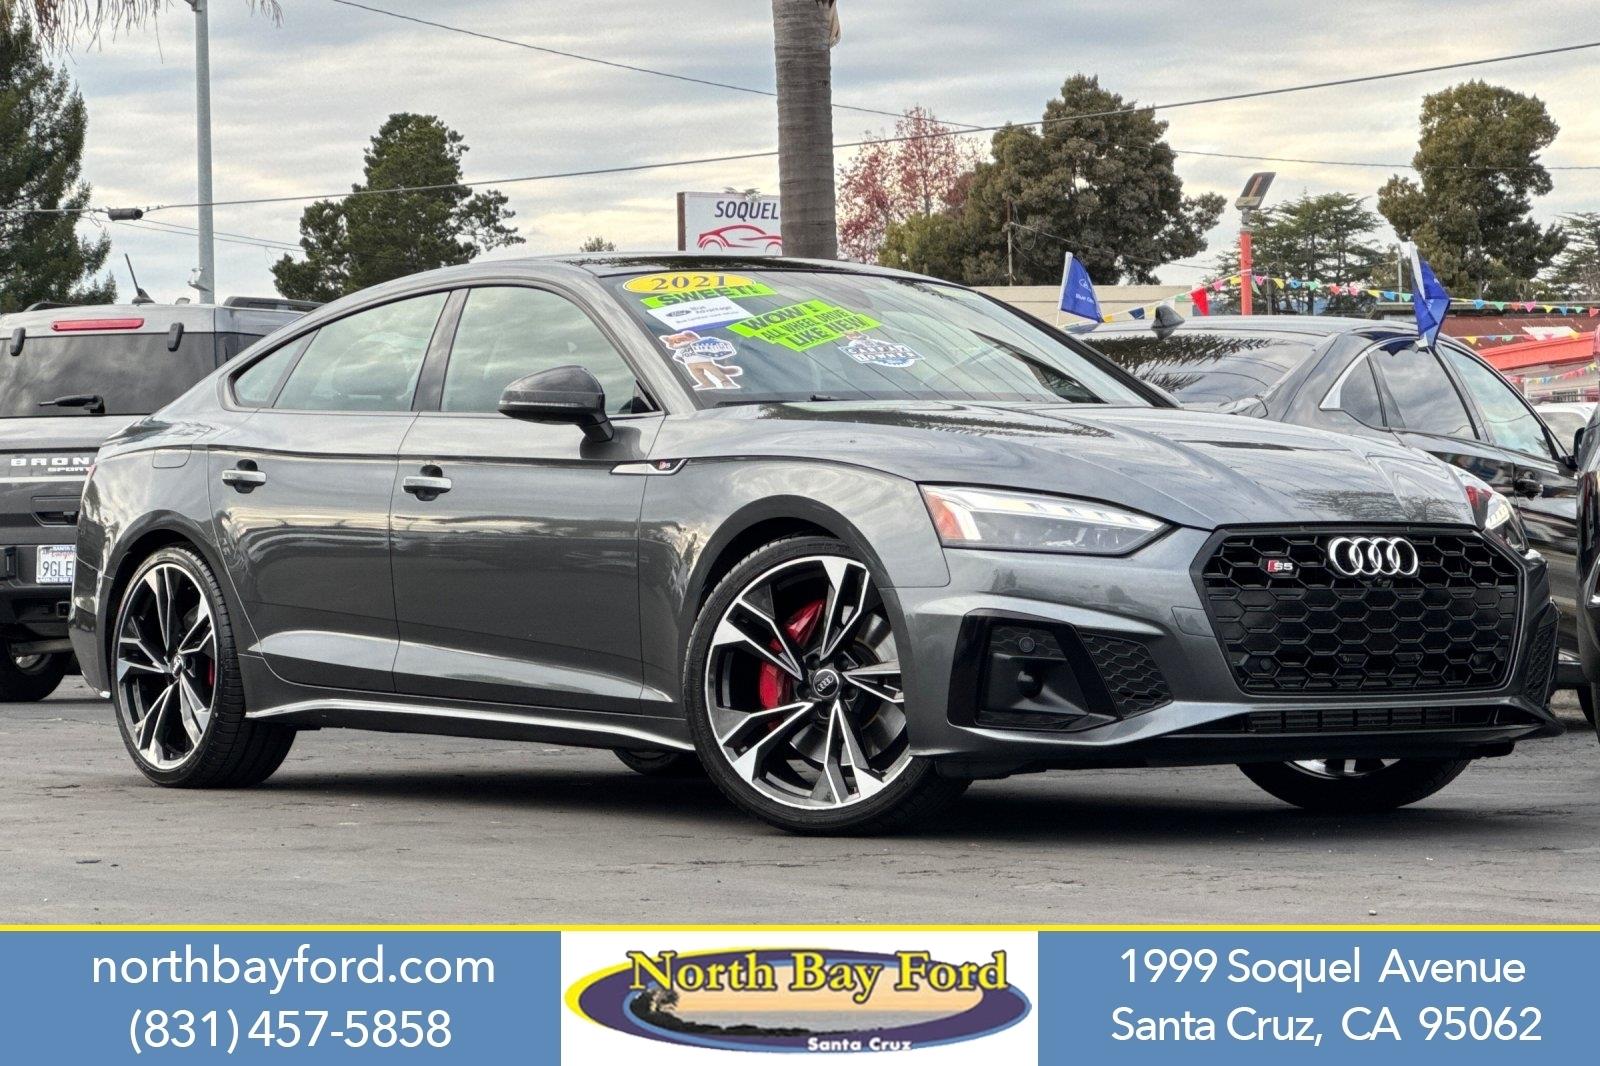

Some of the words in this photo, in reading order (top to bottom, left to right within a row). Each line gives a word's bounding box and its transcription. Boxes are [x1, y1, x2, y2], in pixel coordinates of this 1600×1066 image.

[714, 200, 779, 222] SOQUEL
[651, 275, 727, 290] 2021
[656, 284, 763, 306] SWEET!
[813, 309, 849, 323] DRIVE
[785, 326, 831, 348] LIKE
[10, 457, 96, 466] BRON
[43, 560, 73, 577] 9GLE
[1271, 561, 1293, 571] S5
